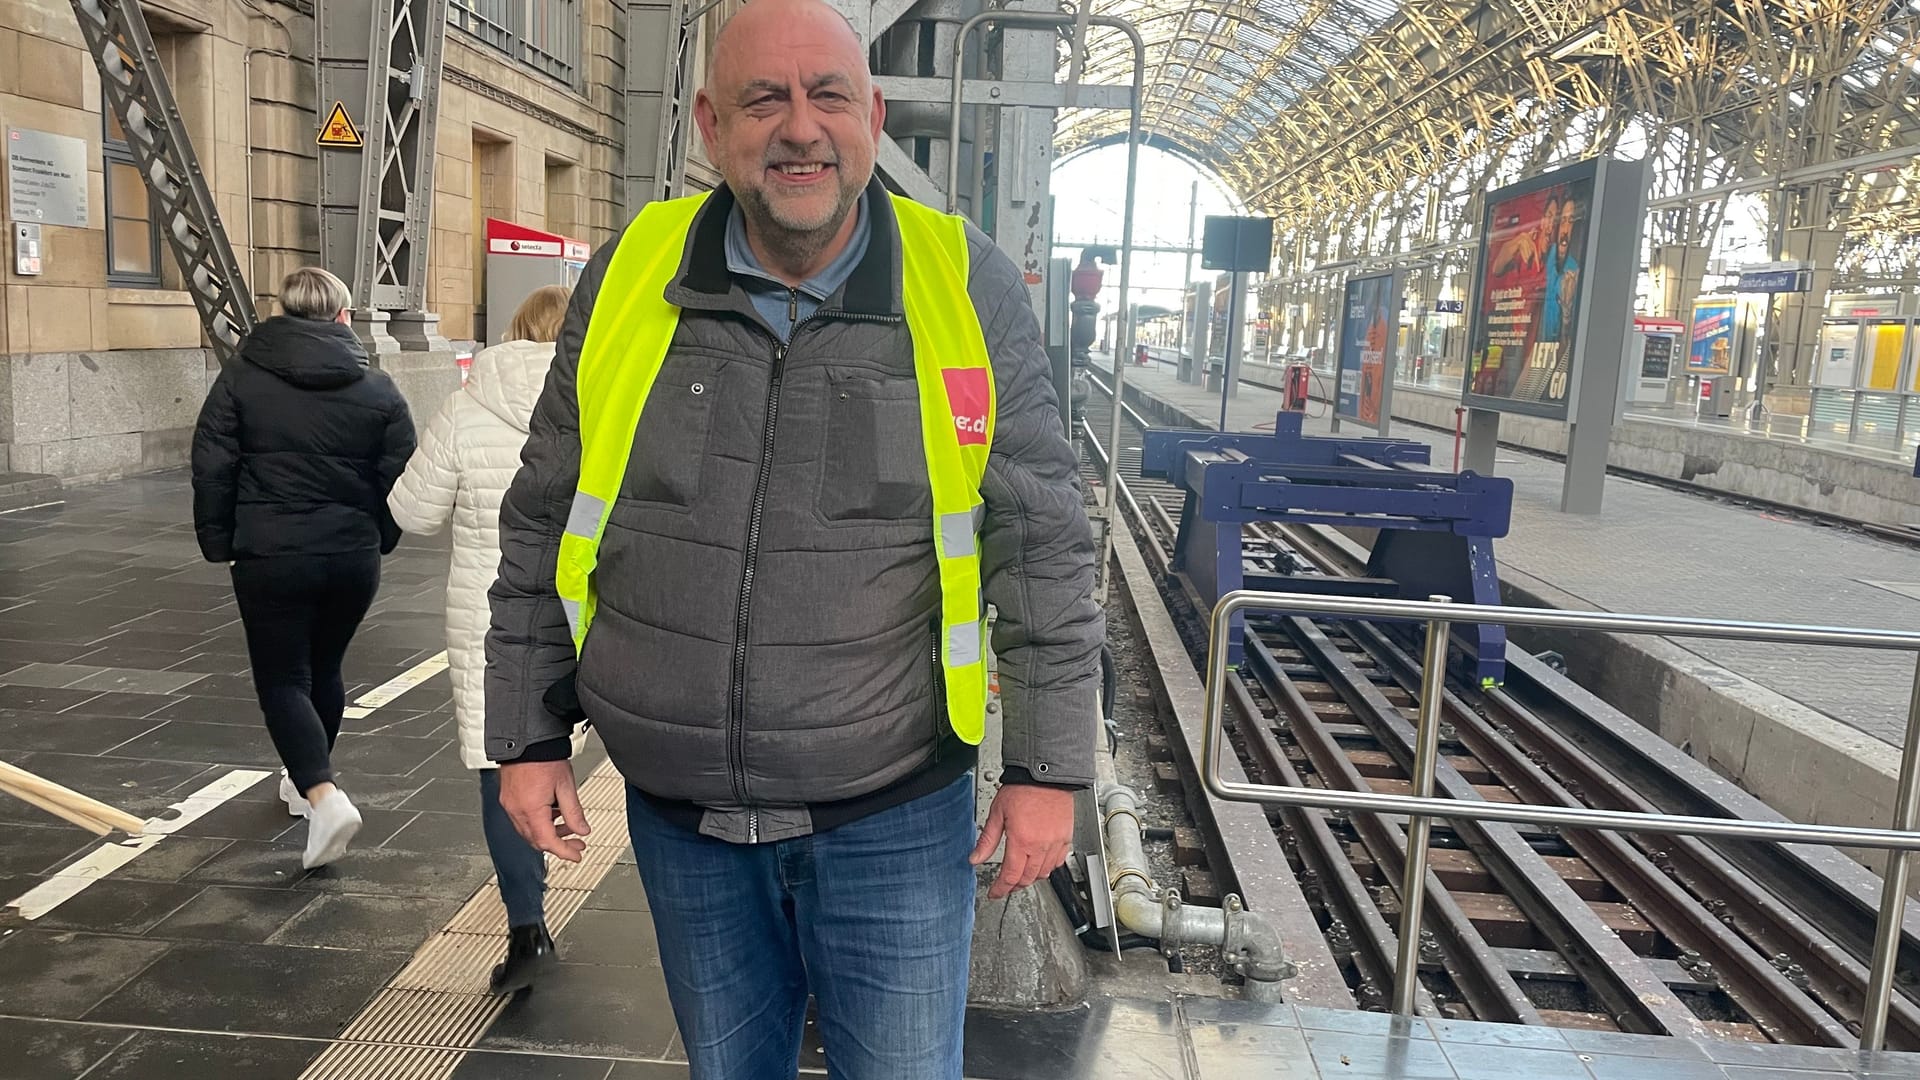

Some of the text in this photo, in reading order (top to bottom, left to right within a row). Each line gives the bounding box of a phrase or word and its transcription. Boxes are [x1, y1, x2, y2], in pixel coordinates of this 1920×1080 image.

[1440, 300, 1463, 312] A 3
[1531, 342, 1560, 369] LET'S
[1549, 371, 1567, 399] GO
